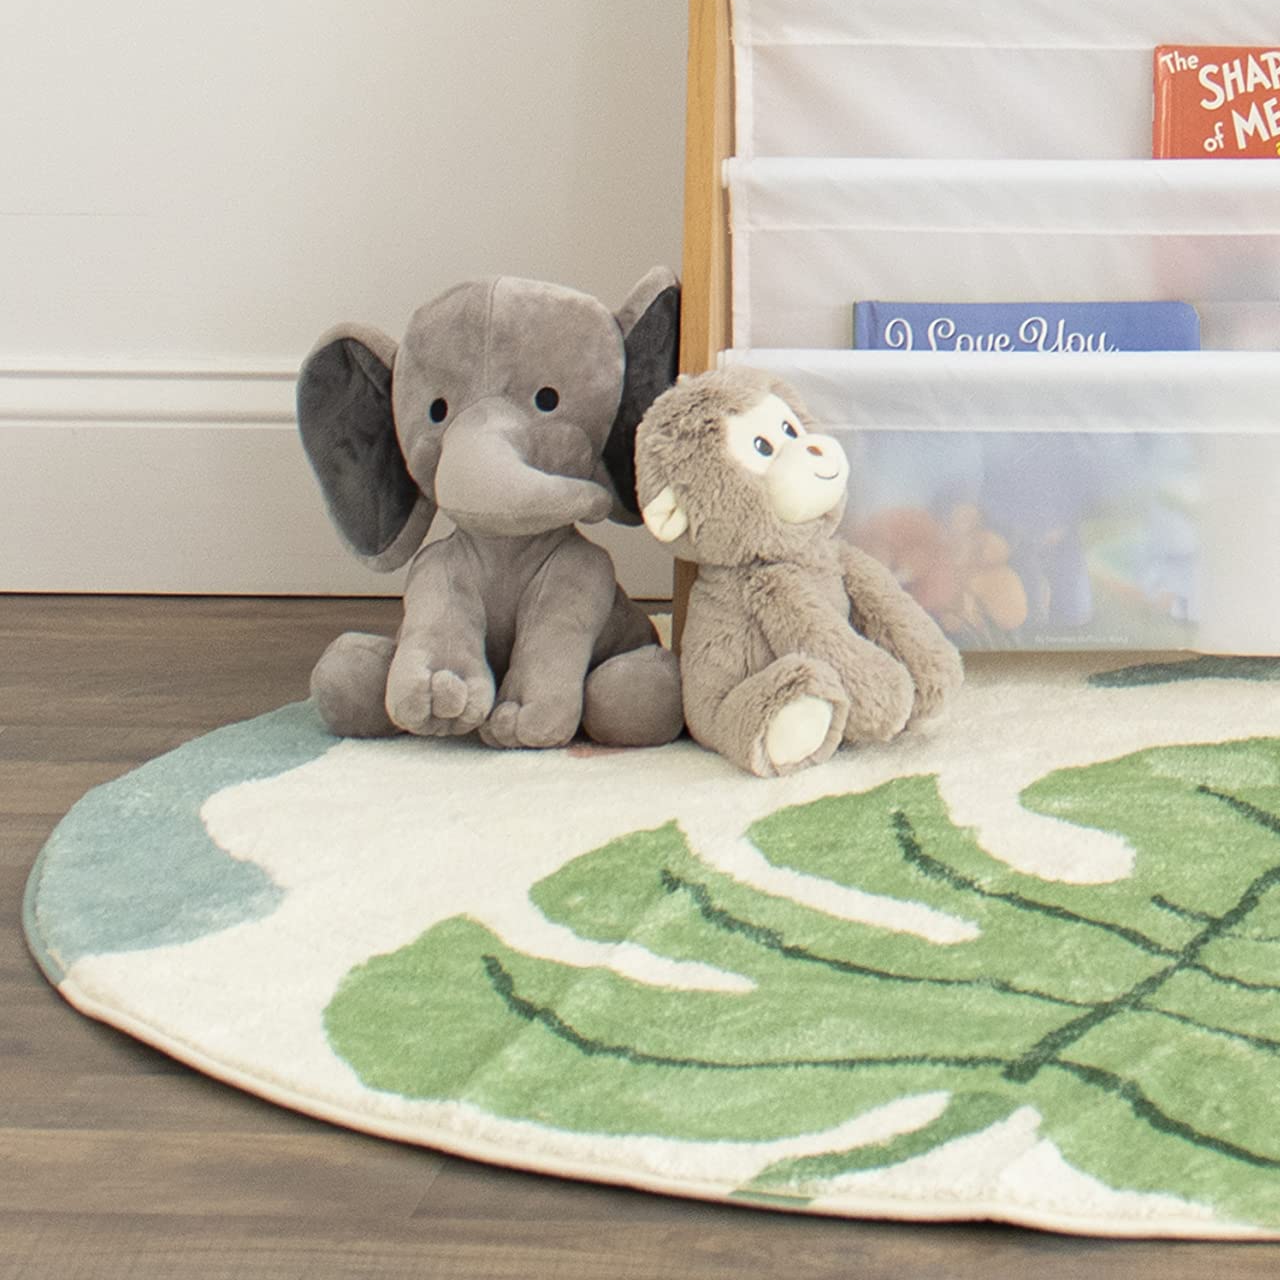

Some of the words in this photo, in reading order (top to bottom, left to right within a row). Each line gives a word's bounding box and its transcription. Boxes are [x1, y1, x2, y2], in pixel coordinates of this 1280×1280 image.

[1160, 51, 1199, 74] The
[1203, 122, 1224, 152] of
[928, 317, 1015, 352] Love
